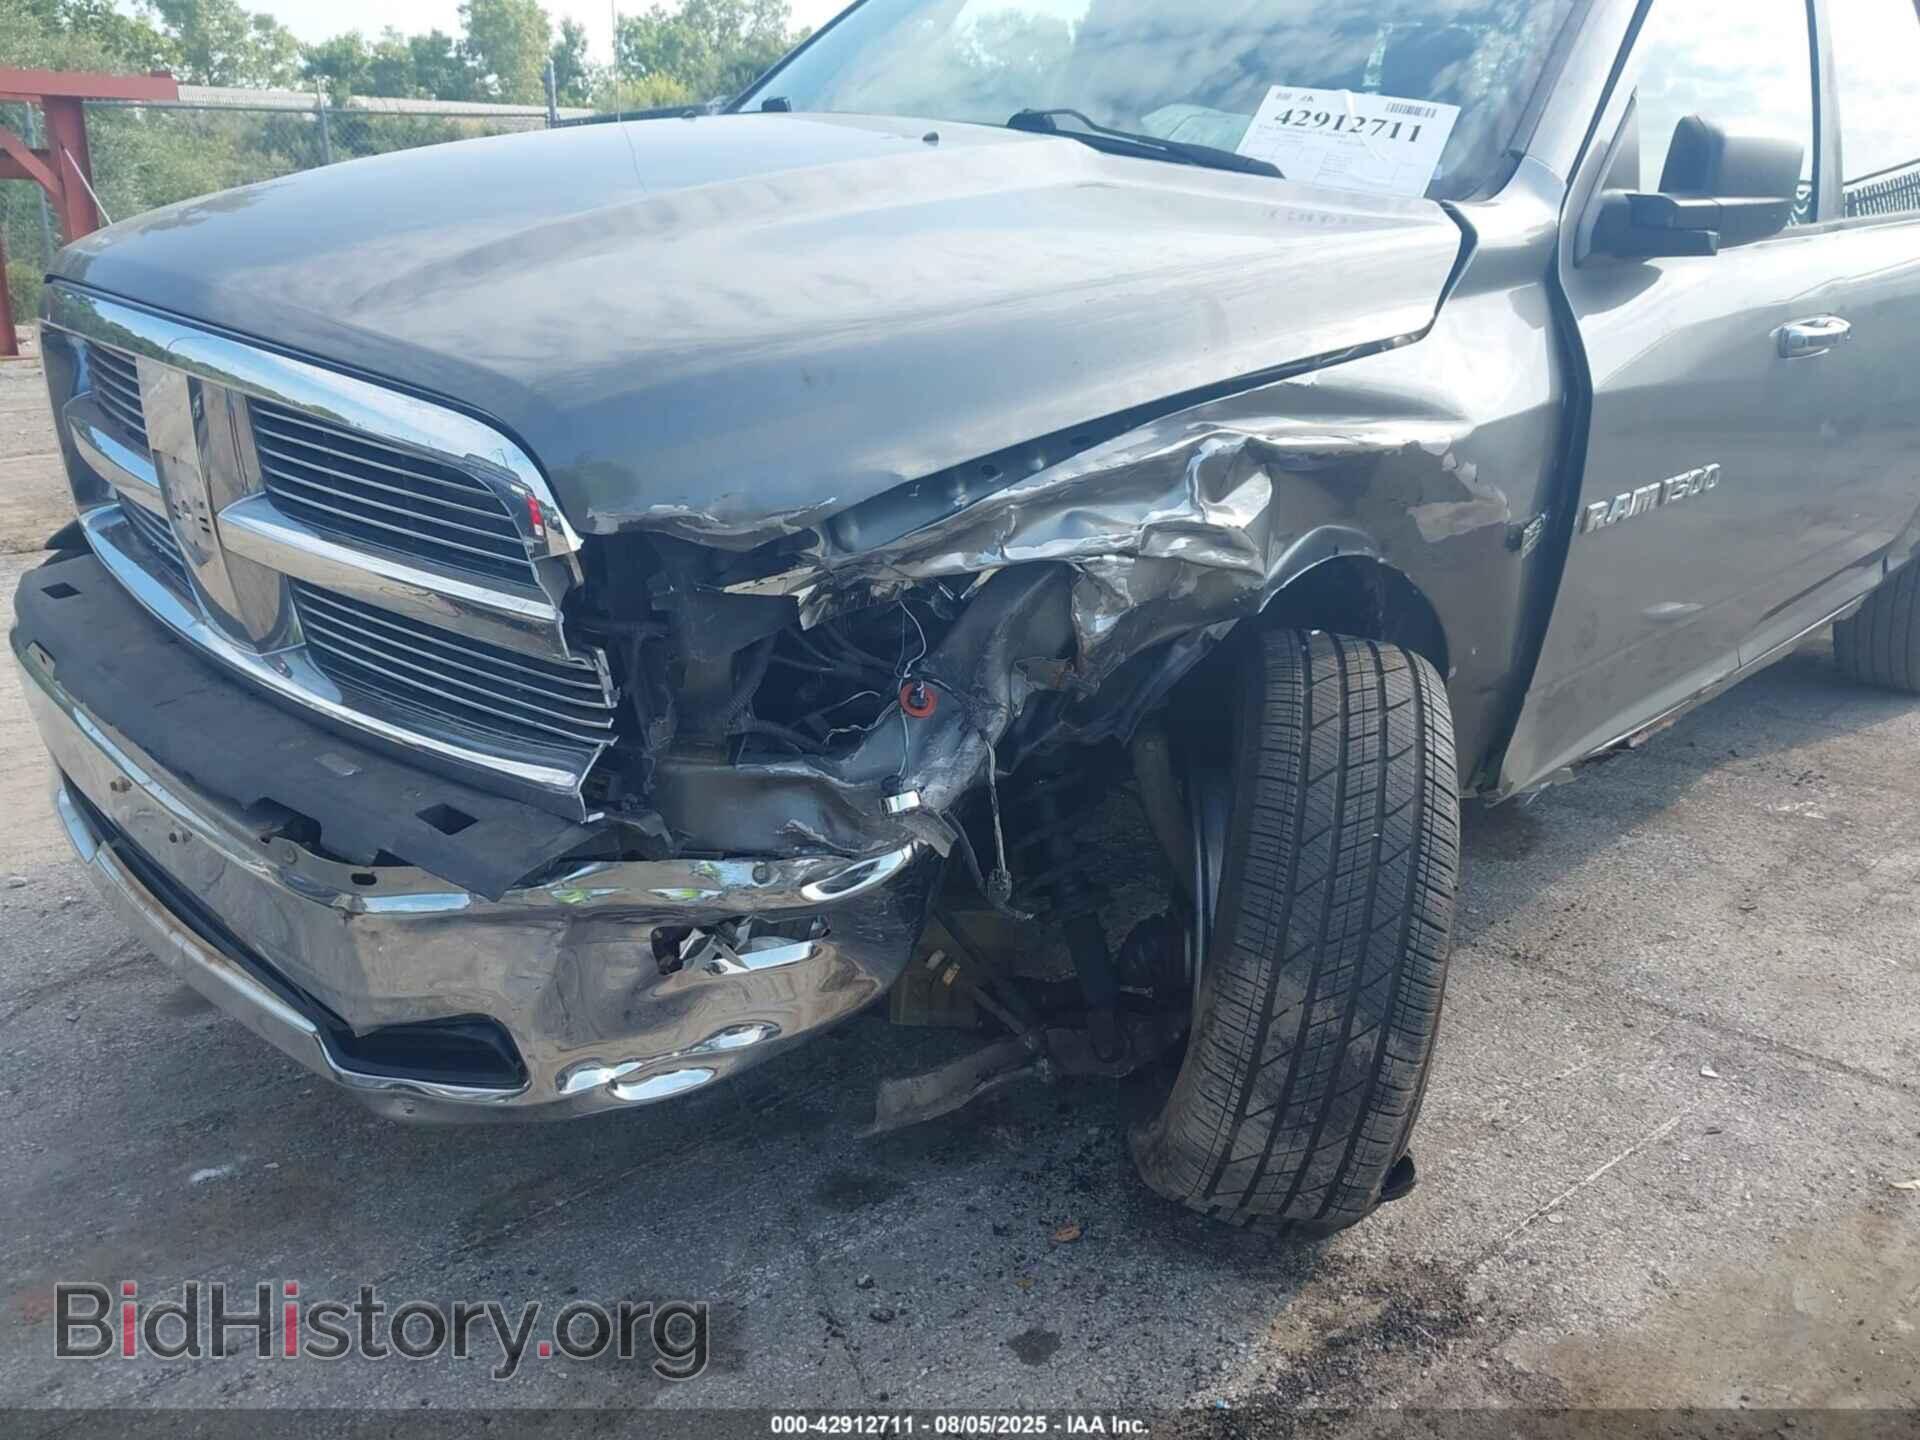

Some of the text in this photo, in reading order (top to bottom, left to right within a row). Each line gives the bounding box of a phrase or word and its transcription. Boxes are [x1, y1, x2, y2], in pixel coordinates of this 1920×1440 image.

[1274, 106, 1423, 143] 42912711
[1582, 462, 1721, 534] RAM 1500
